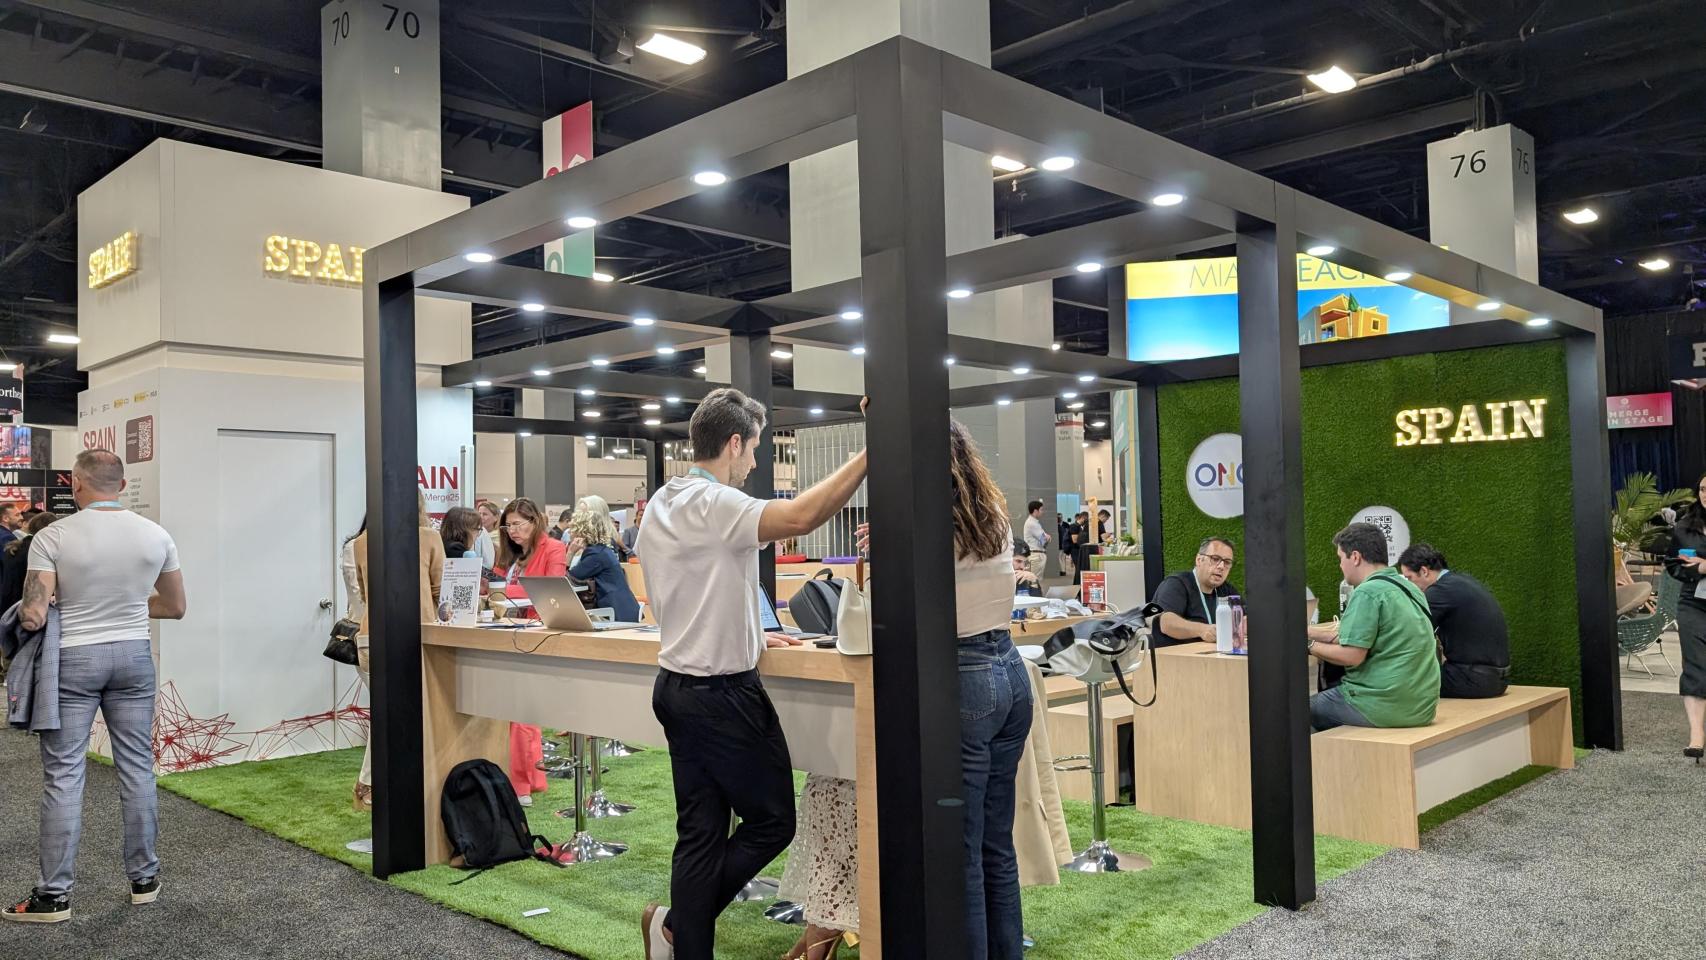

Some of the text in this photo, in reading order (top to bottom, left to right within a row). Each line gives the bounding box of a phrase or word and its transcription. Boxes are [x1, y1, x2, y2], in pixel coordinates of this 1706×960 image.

[332, 11, 350, 46] 70
[382, 3, 420, 39] 70
[1450, 149, 1487, 178] 76
[1516, 147, 1530, 175] 76
[1299, 257, 1366, 283] EAC
[1395, 398, 1548, 447] SPAIN
[1623, 415, 1664, 425] STAGE
[83, 424, 116, 454] SPAIN
